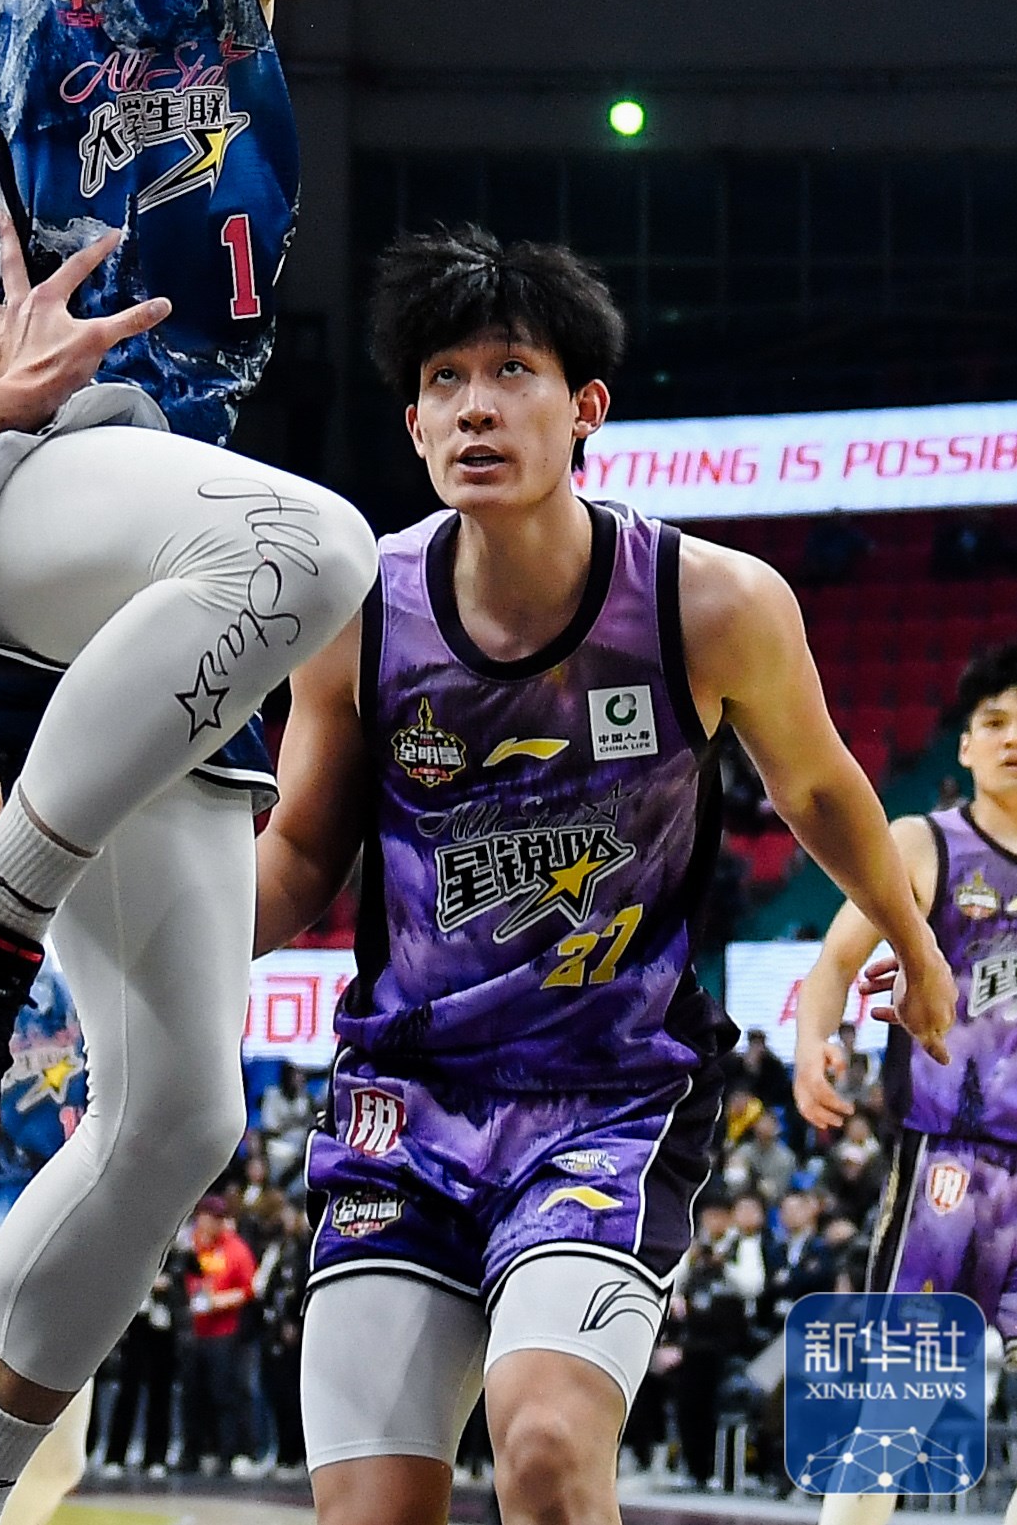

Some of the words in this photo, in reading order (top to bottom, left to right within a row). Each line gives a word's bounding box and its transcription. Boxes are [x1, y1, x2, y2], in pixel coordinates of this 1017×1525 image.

[221, 213, 261, 320] 1
[779, 445, 823, 483] IS
[539, 903, 644, 990] 27
